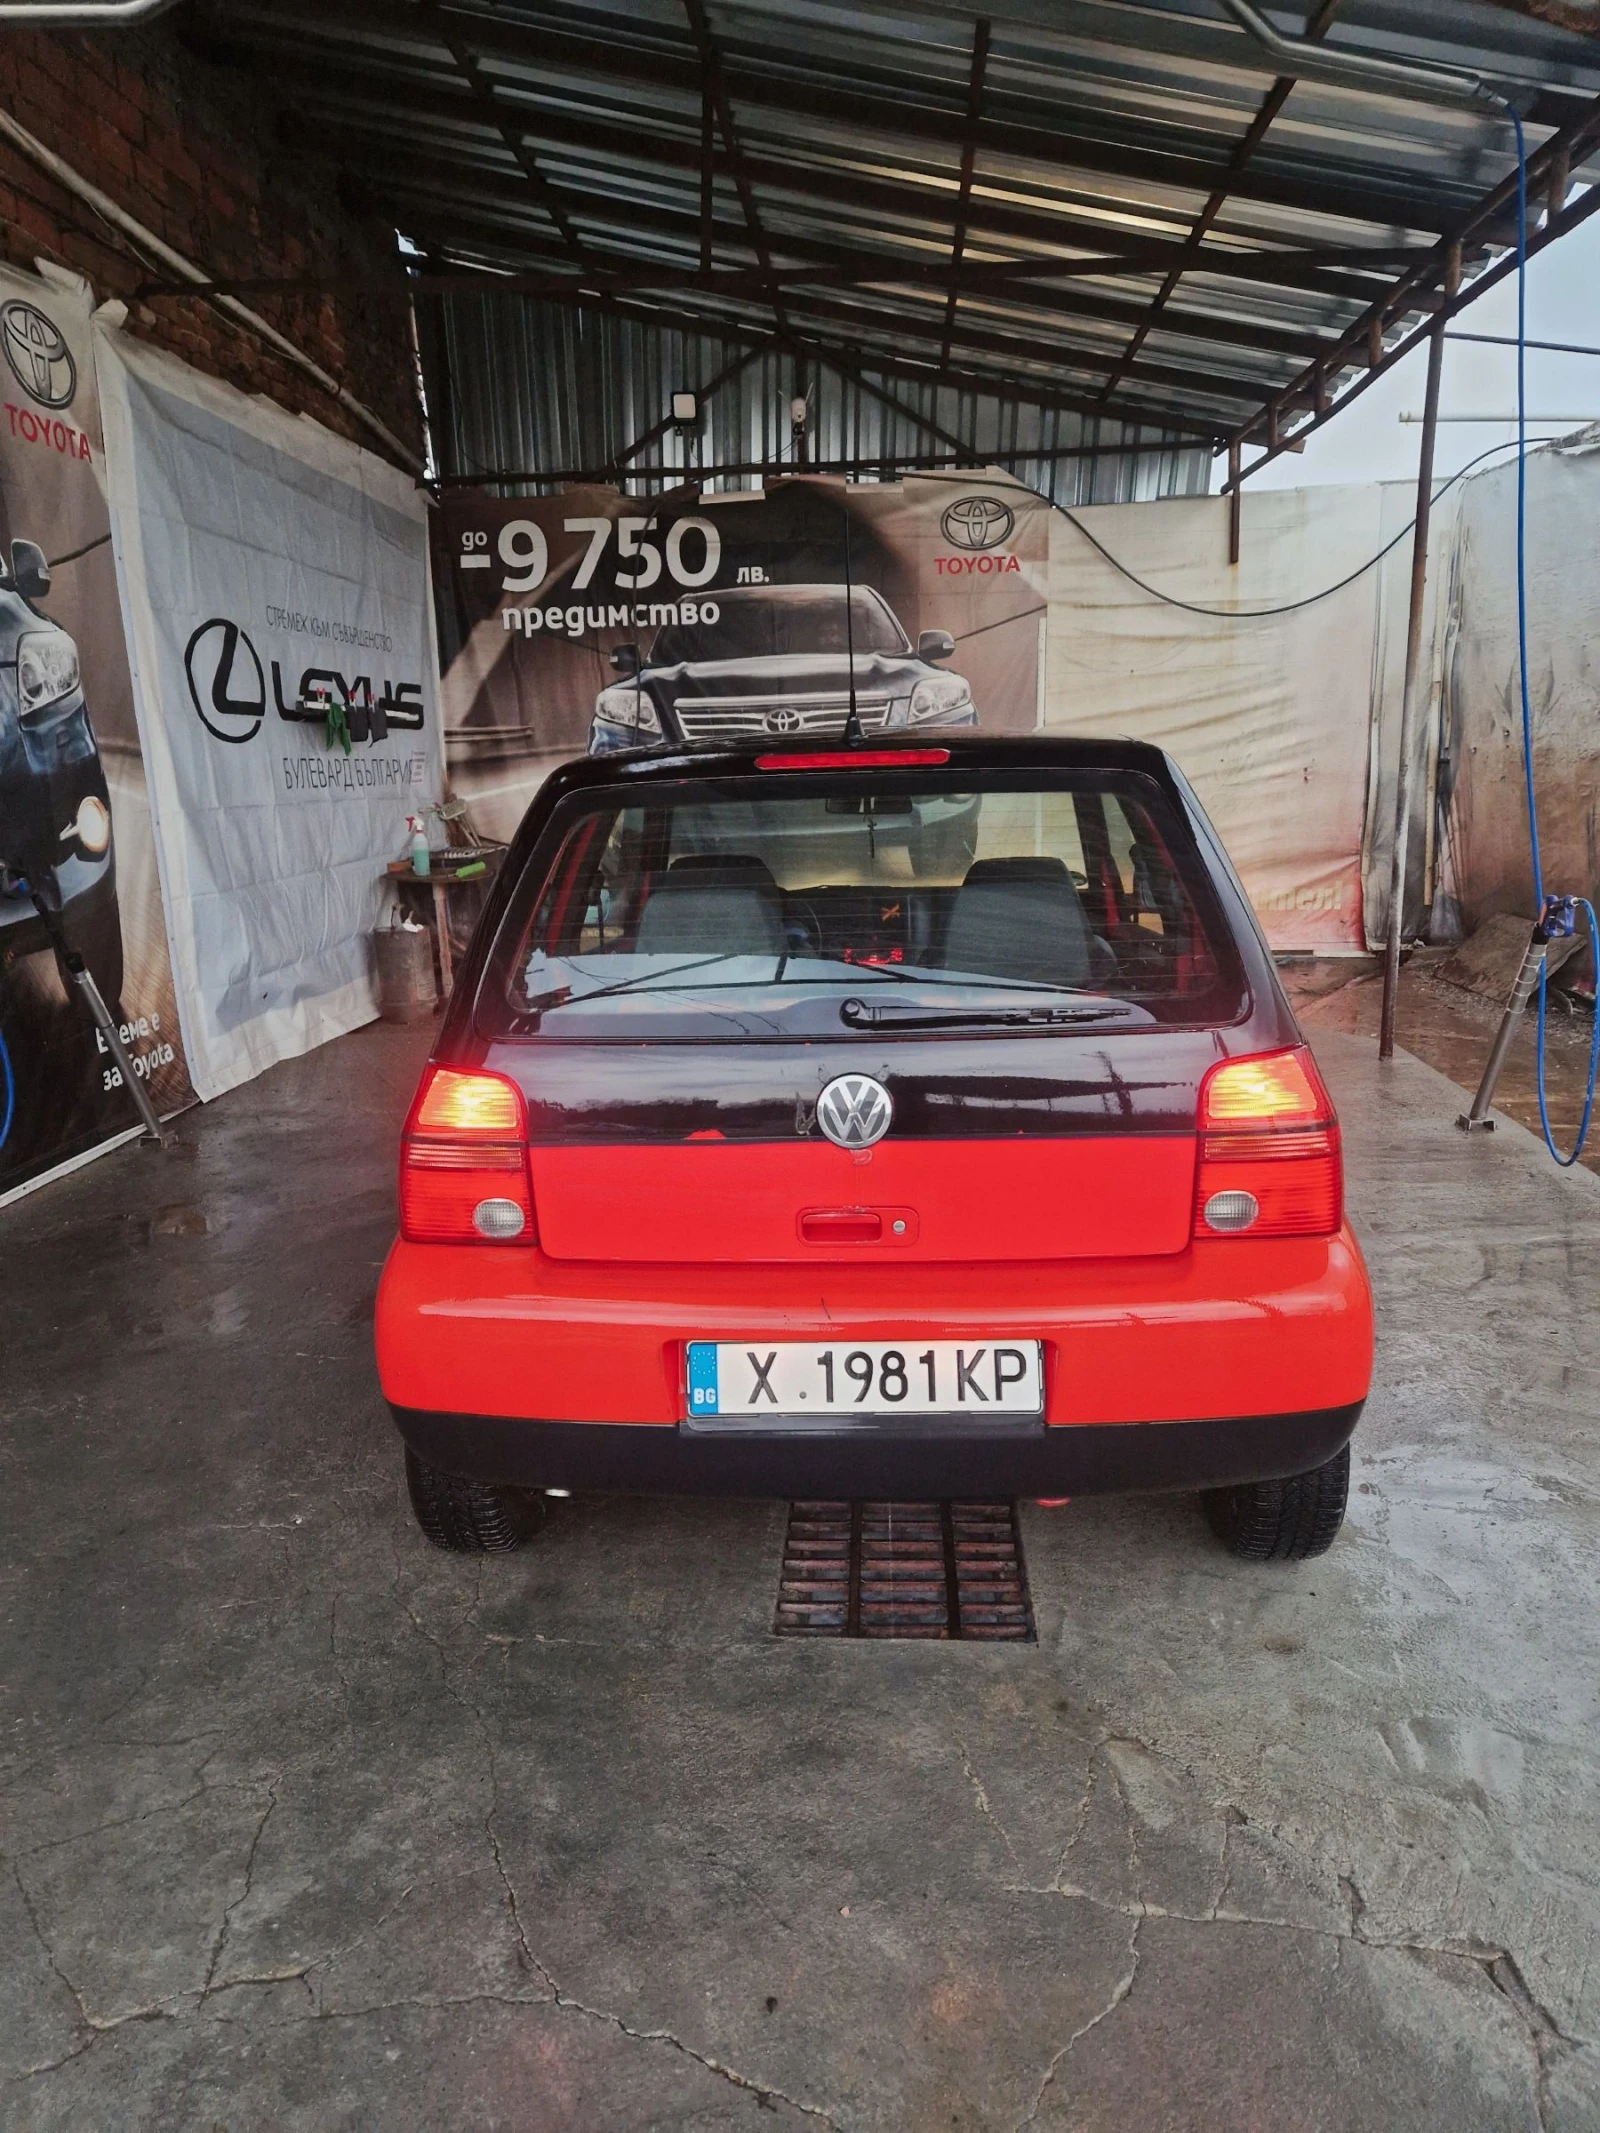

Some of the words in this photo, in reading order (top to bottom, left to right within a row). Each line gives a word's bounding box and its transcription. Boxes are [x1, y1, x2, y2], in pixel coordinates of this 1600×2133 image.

[4, 403, 92, 464] TOYOTA
[736, 566, 770, 584] лв.
[934, 555, 1021, 575] TOYOTA
[309, 617, 331, 639] КЪМ
[501, 601, 721, 638] предимство
[271, 660, 424, 731] LEXUS
[282, 757, 355, 792] БУЛЕВАРД
[95, 1016, 150, 1054] Веме
[102, 1065, 124, 1091] за
[128, 1043, 175, 1080] oyota
[693, 1387, 717, 1405] BG
